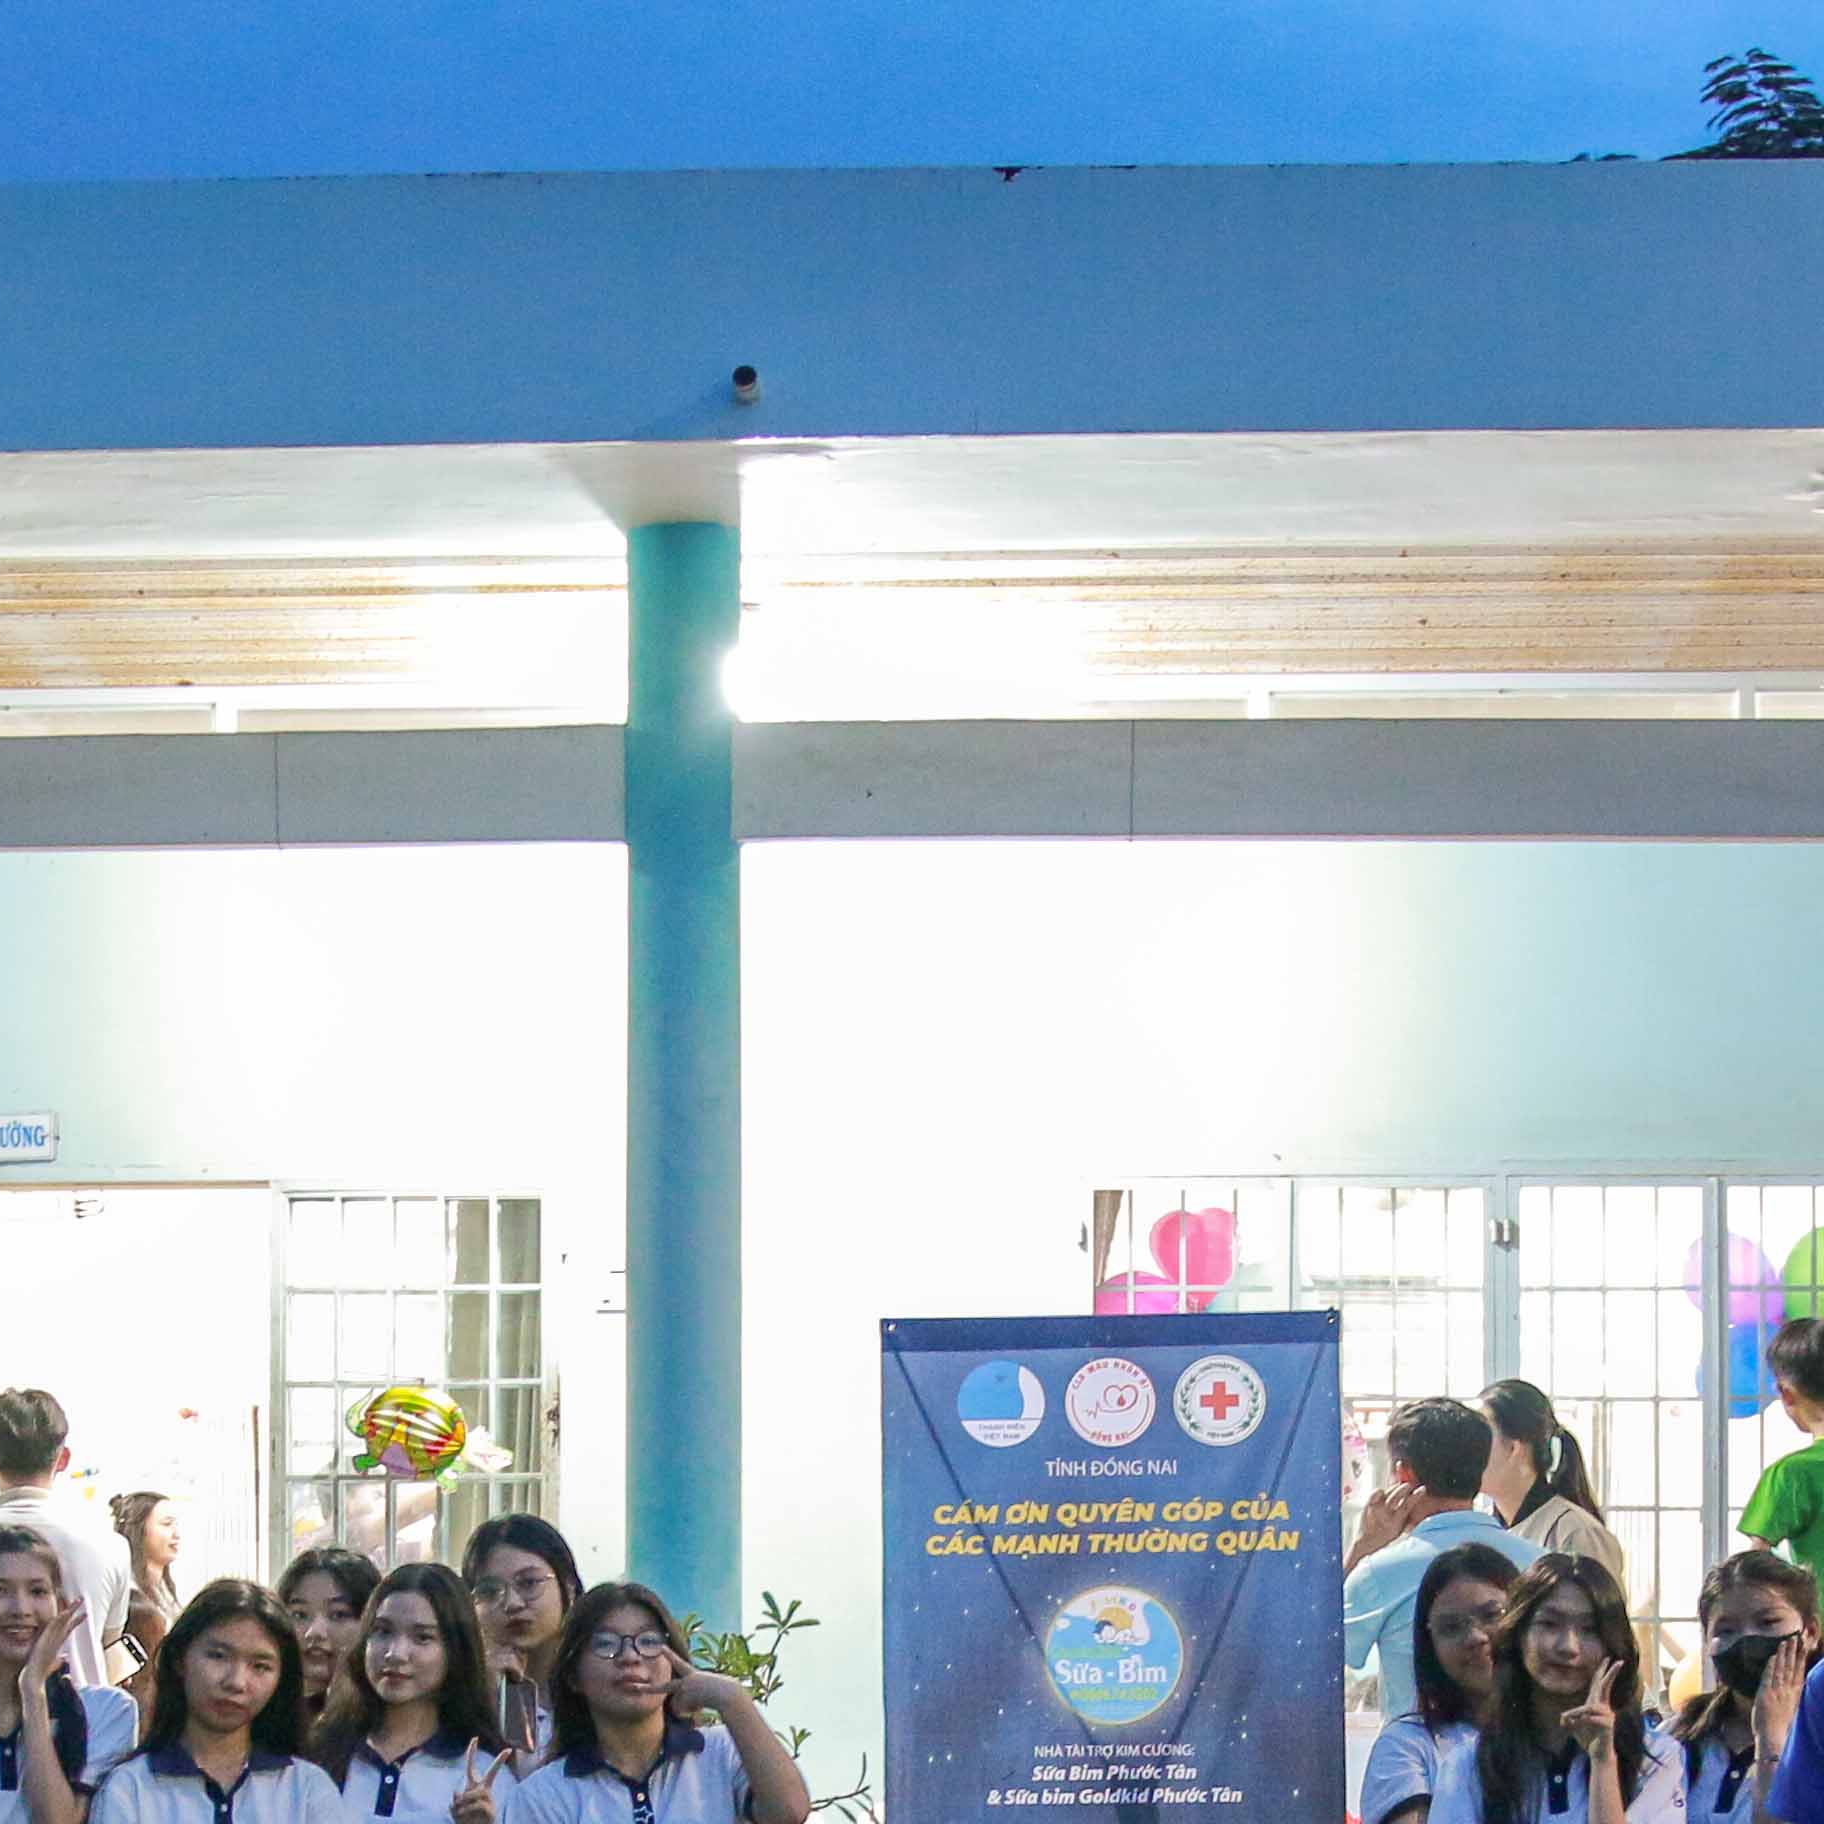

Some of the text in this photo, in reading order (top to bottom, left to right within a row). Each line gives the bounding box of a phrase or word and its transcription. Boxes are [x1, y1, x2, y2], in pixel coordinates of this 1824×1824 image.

[1148, 1459, 1177, 1476] NAI
[1005, 1500, 1050, 1525] ƠN
[1056, 1497, 1155, 1527] QUYÊN
[1162, 1496, 1224, 1522] GÓP
[1231, 1492, 1290, 1521] CỦA
[926, 1525, 1300, 1560] CÁC MẠNH THƯỜNG QUÂN
[1055, 1659, 1104, 1684] Sữa
[1034, 1743, 1064, 1757] NHÀ
[1065, 1743, 1085, 1757] TÀI
[1086, 1744, 1114, 1759] TRỢ
[1116, 1744, 1140, 1757] KIM
[1032, 1765, 1066, 1781] Sữa
[1106, 1763, 1162, 1780] Phước
[1166, 1763, 1197, 1780] Tân
[987, 1789, 1002, 1805] &
[1004, 1788, 1040, 1805] Sữa
[1079, 1787, 1150, 1805] Goldkid
[1152, 1786, 1208, 1803] Phước
[1211, 1786, 1243, 1803] Tân
